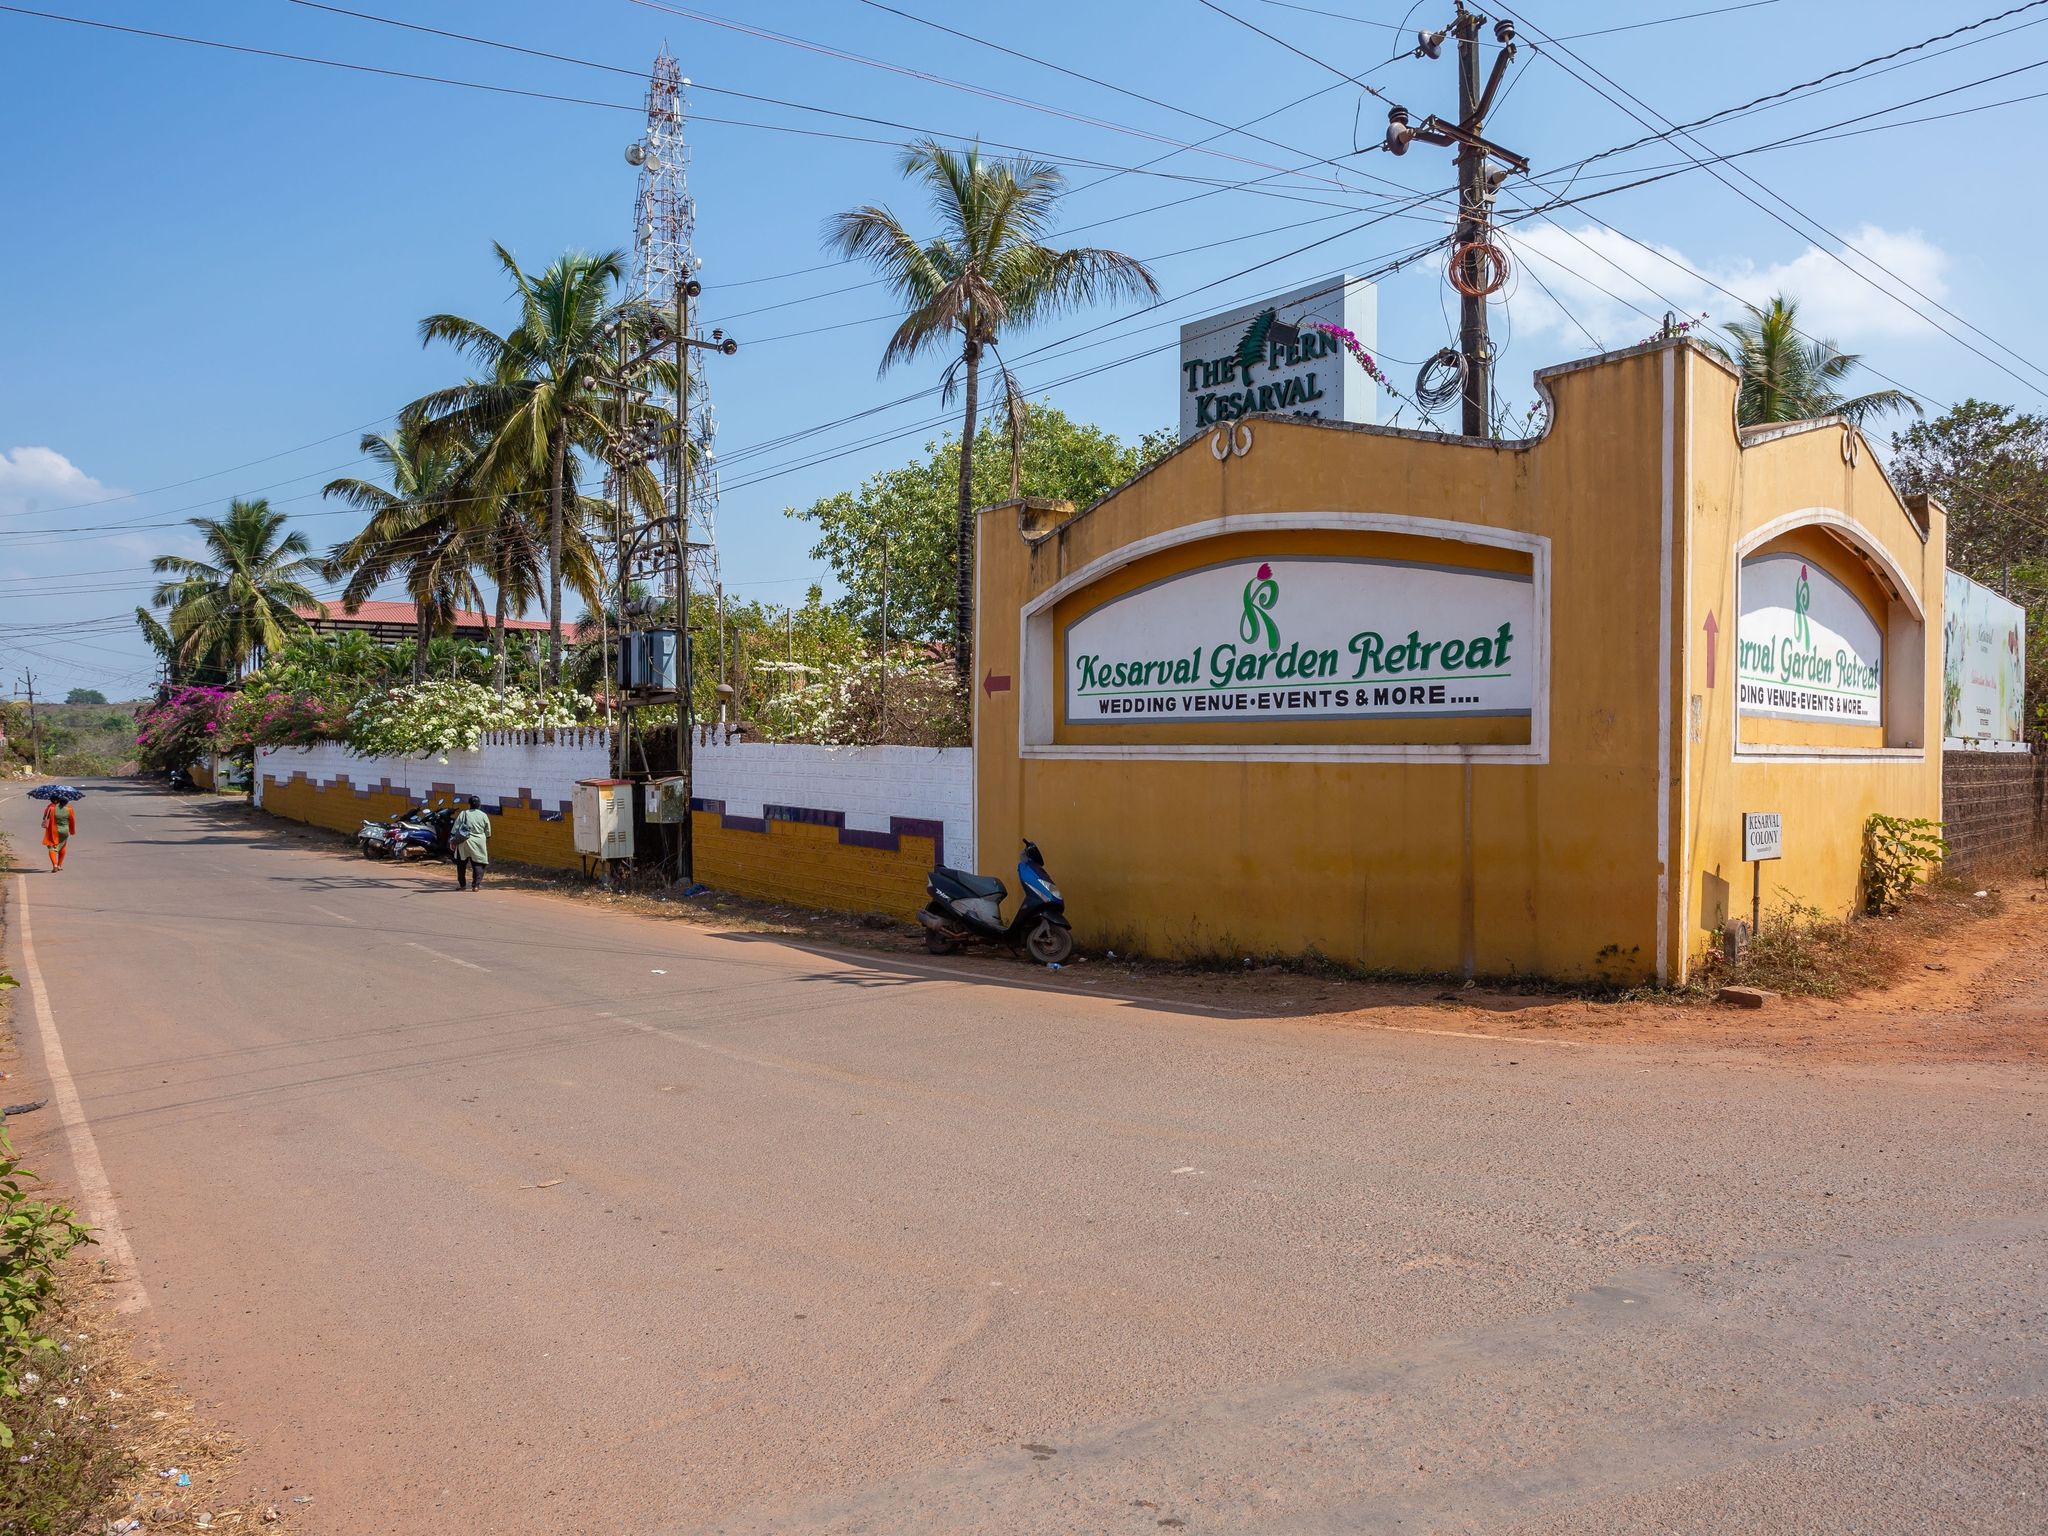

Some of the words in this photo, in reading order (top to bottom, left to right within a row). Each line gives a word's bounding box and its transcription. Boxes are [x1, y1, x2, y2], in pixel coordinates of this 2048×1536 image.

[1183, 355, 1236, 392] THE
[1268, 331, 1338, 370] FERN
[1195, 372, 1323, 427] KESARVAL
[1076, 646, 1202, 691] Kesarval
[1209, 641, 1339, 688] Garden
[1348, 621, 1514, 680] Retreat
[1780, 637, 1832, 684] Garden
[1836, 649, 1879, 690] Retreat
[1099, 696, 1177, 714] WEDDING
[1355, 688, 1369, 706] &
[1749, 814, 1779, 830] KESARVAL
[1750, 830, 1778, 846] COLONY
